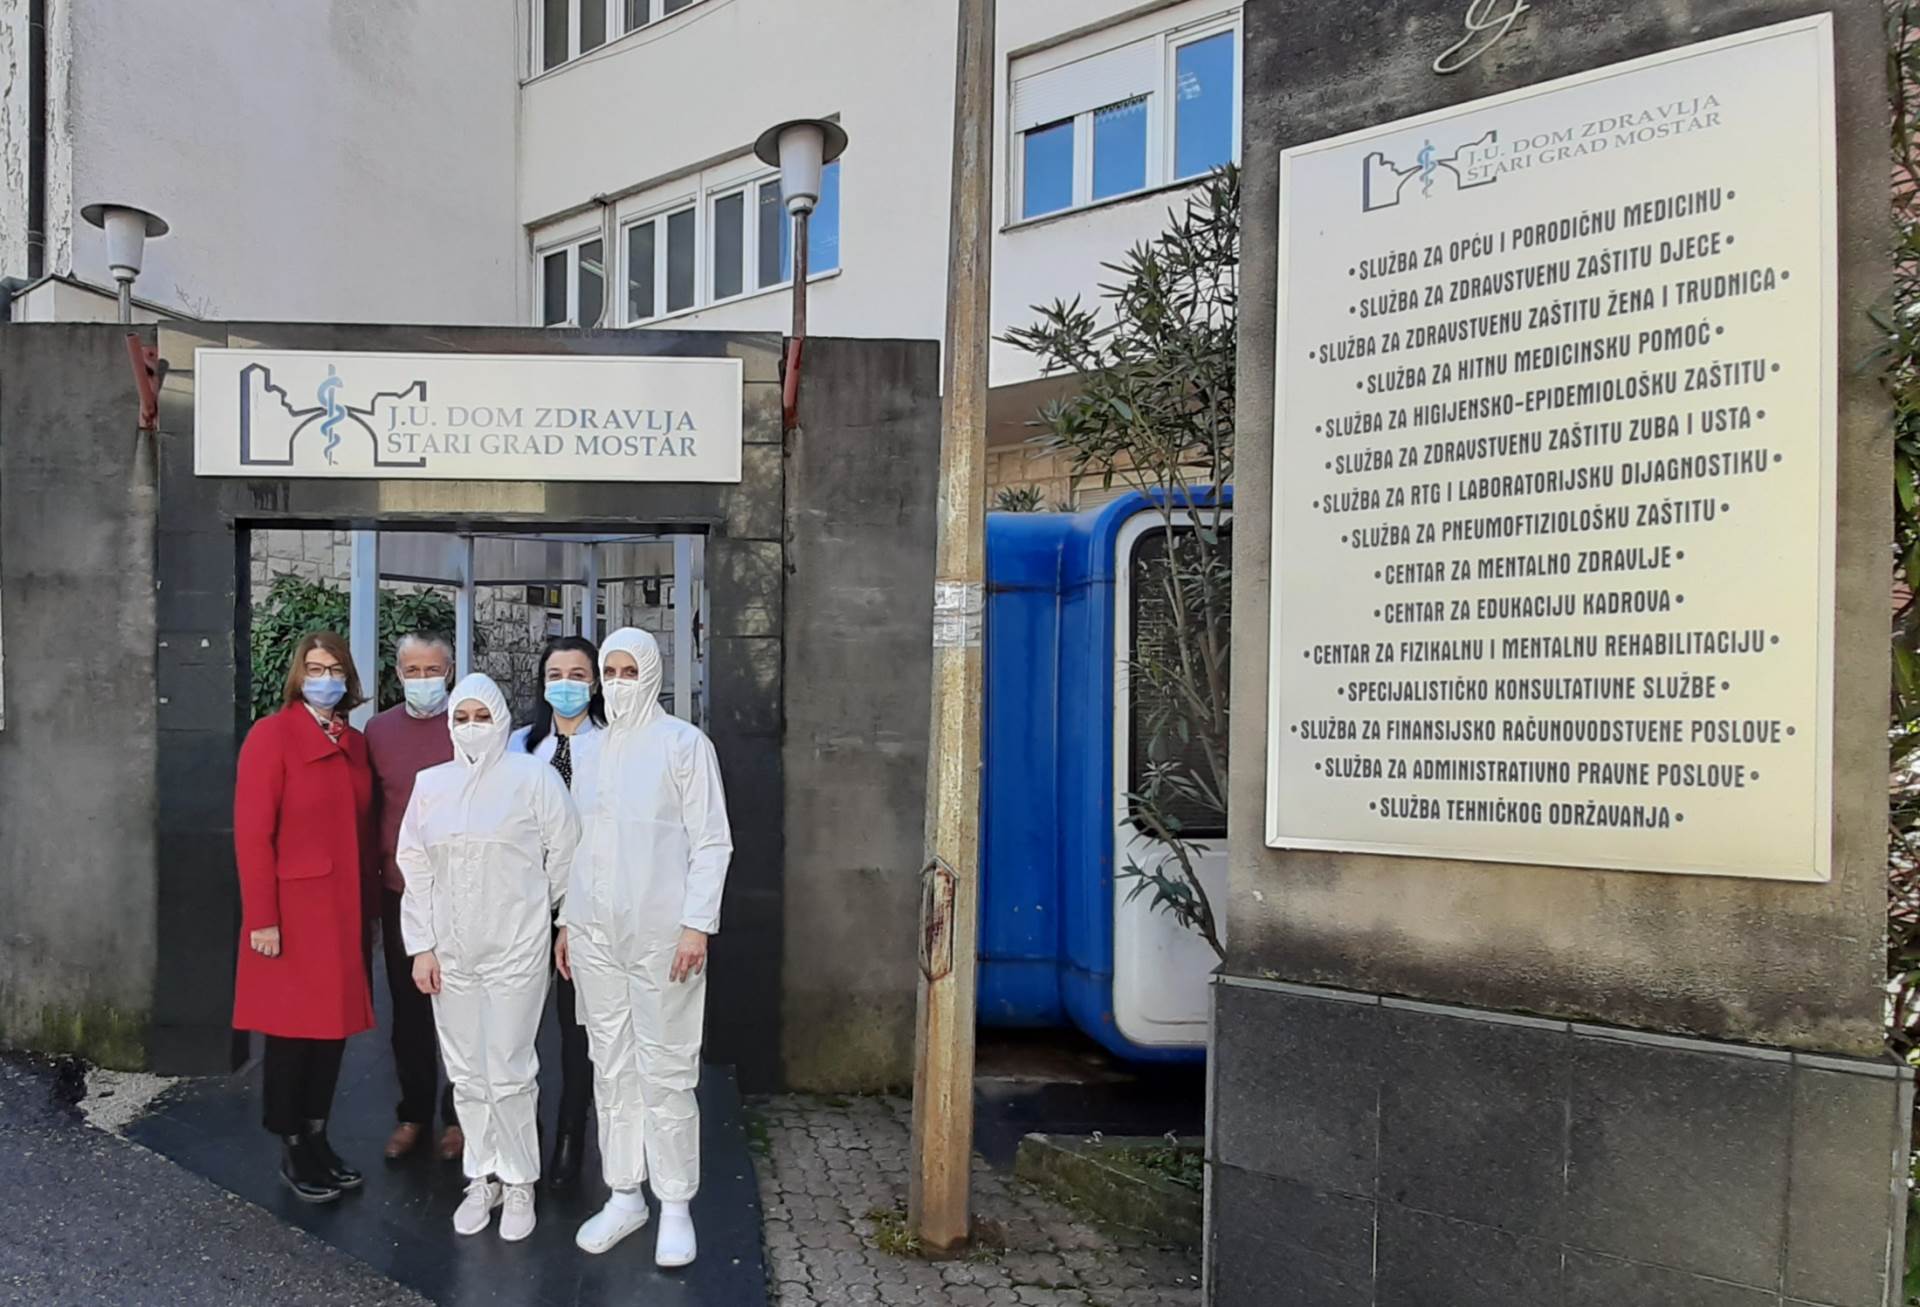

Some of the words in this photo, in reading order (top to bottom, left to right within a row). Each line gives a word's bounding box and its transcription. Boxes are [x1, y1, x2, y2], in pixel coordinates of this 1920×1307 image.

[1467, 154, 1532, 181] STARI
[1538, 137, 1608, 164] GRAD
[1613, 111, 1721, 148] MOSTAR
[1512, 127, 1574, 153] DOM
[1581, 94, 1720, 138] ZDRAVLJA
[1359, 250, 1418, 281] SLUŽBA
[1423, 245, 1443, 268] ZA
[1449, 233, 1494, 263] OPĆU
[1500, 231, 1505, 253] I
[1512, 208, 1616, 251] PORODIČNU
[1623, 187, 1722, 228] MEDICINU
[1359, 289, 1419, 319] SLUŽBA
[1424, 284, 1444, 308] ZA
[1449, 259, 1571, 303] ZDRAVSTVENU
[1576, 244, 1652, 280] ZAŠTITU
[1659, 231, 1721, 265] DJECE
[1319, 335, 1376, 365] SLUŽBA
[1381, 331, 1400, 354] ZA
[1405, 309, 1522, 350] ZDRAVSTVENU
[1527, 296, 1601, 330] ZAŠTITU
[1607, 287, 1655, 317] ŽENA
[1662, 284, 1668, 308] I
[1675, 267, 1776, 305] TRUDNICA
[1367, 365, 1427, 395] SLUŽBA
[1431, 362, 1452, 385] ZA
[1457, 353, 1508, 381] HITNU
[1514, 334, 1631, 373] MEDICINSKU
[1638, 317, 1711, 355] POMOĆ
[447, 406, 525, 428] DOM
[534, 407, 697, 435] ZDRAVLJA
[1325, 410, 1383, 439] SLUŽBA
[1388, 408, 1407, 431] ZA
[1413, 370, 1677, 427] HIGIJENSKO-EPIDEMIOLOŠKU
[1684, 358, 1766, 392] ZAŠTITU
[386, 432, 472, 454] STARI
[479, 433, 564, 456] GRAD
[574, 435, 697, 457] MOSTAR
[1335, 447, 1394, 475] SLUŽBA
[1398, 446, 1418, 468] ZA
[1423, 430, 1542, 465] ZDRAVSTVENU
[1548, 421, 1622, 451] ZAŠTITU
[1628, 414, 1680, 442] ZUBA
[1687, 412, 1693, 435] I
[1701, 405, 1751, 434] USTA
[1322, 487, 1381, 514] SLUŽBA
[1385, 486, 1405, 508] ZA
[1410, 482, 1441, 506] RTG
[1447, 481, 1452, 502] I
[1458, 464, 1614, 501] LABORATORIJSKU
[1621, 448, 1768, 486] DIJAGNOSTIKU
[1351, 522, 1411, 549] SLUŽBA
[1415, 522, 1436, 545] ZA
[1441, 503, 1630, 542] PNEUMOFTIZIOLOŠKU
[1635, 497, 1716, 527] ZAŠTITU
[1385, 561, 1446, 585] CENTAR
[1450, 559, 1471, 581] ZA
[1477, 552, 1571, 580] MENTALNO
[1577, 545, 1672, 574] ZDRAVLJE
[1384, 600, 1445, 624] CENTAR
[1449, 599, 1471, 621] ZA
[1477, 593, 1576, 620] EDUKACIJU
[1583, 589, 1671, 616] KADROVA
[1313, 643, 1370, 665] CENTAR
[1375, 642, 1395, 663] ZA
[1400, 639, 1484, 663] FIZIKALNU
[1490, 638, 1495, 660] I
[1502, 635, 1598, 660] MENTALNU
[1605, 629, 1765, 657] REHABILITACIJU
[1347, 675, 1488, 702] SPECIJALISTIČKO
[1494, 676, 1636, 701] KONSULTATIVNE
[1642, 671, 1716, 700] SLUŽBE
[1300, 715, 1357, 740] SLUŽBA
[1361, 719, 1381, 741] ZA
[1386, 719, 1496, 742] FINANSIJSKO
[1502, 715, 1683, 743] RAČUNOVODSTVENE
[1691, 719, 1781, 744] POSLOVE
[1324, 753, 1383, 779] SLUŽBA
[1387, 758, 1407, 780] ZA
[1412, 759, 1570, 784] ADMINISTRATIVNO
[1577, 761, 1650, 786] PRAVNE
[1657, 763, 1745, 788] POSLOVE
[1380, 794, 1441, 820] SLUŽBA
[1446, 796, 1542, 824] TEHNIČKOG
[1548, 799, 1670, 829] ODRŽAVANJA
